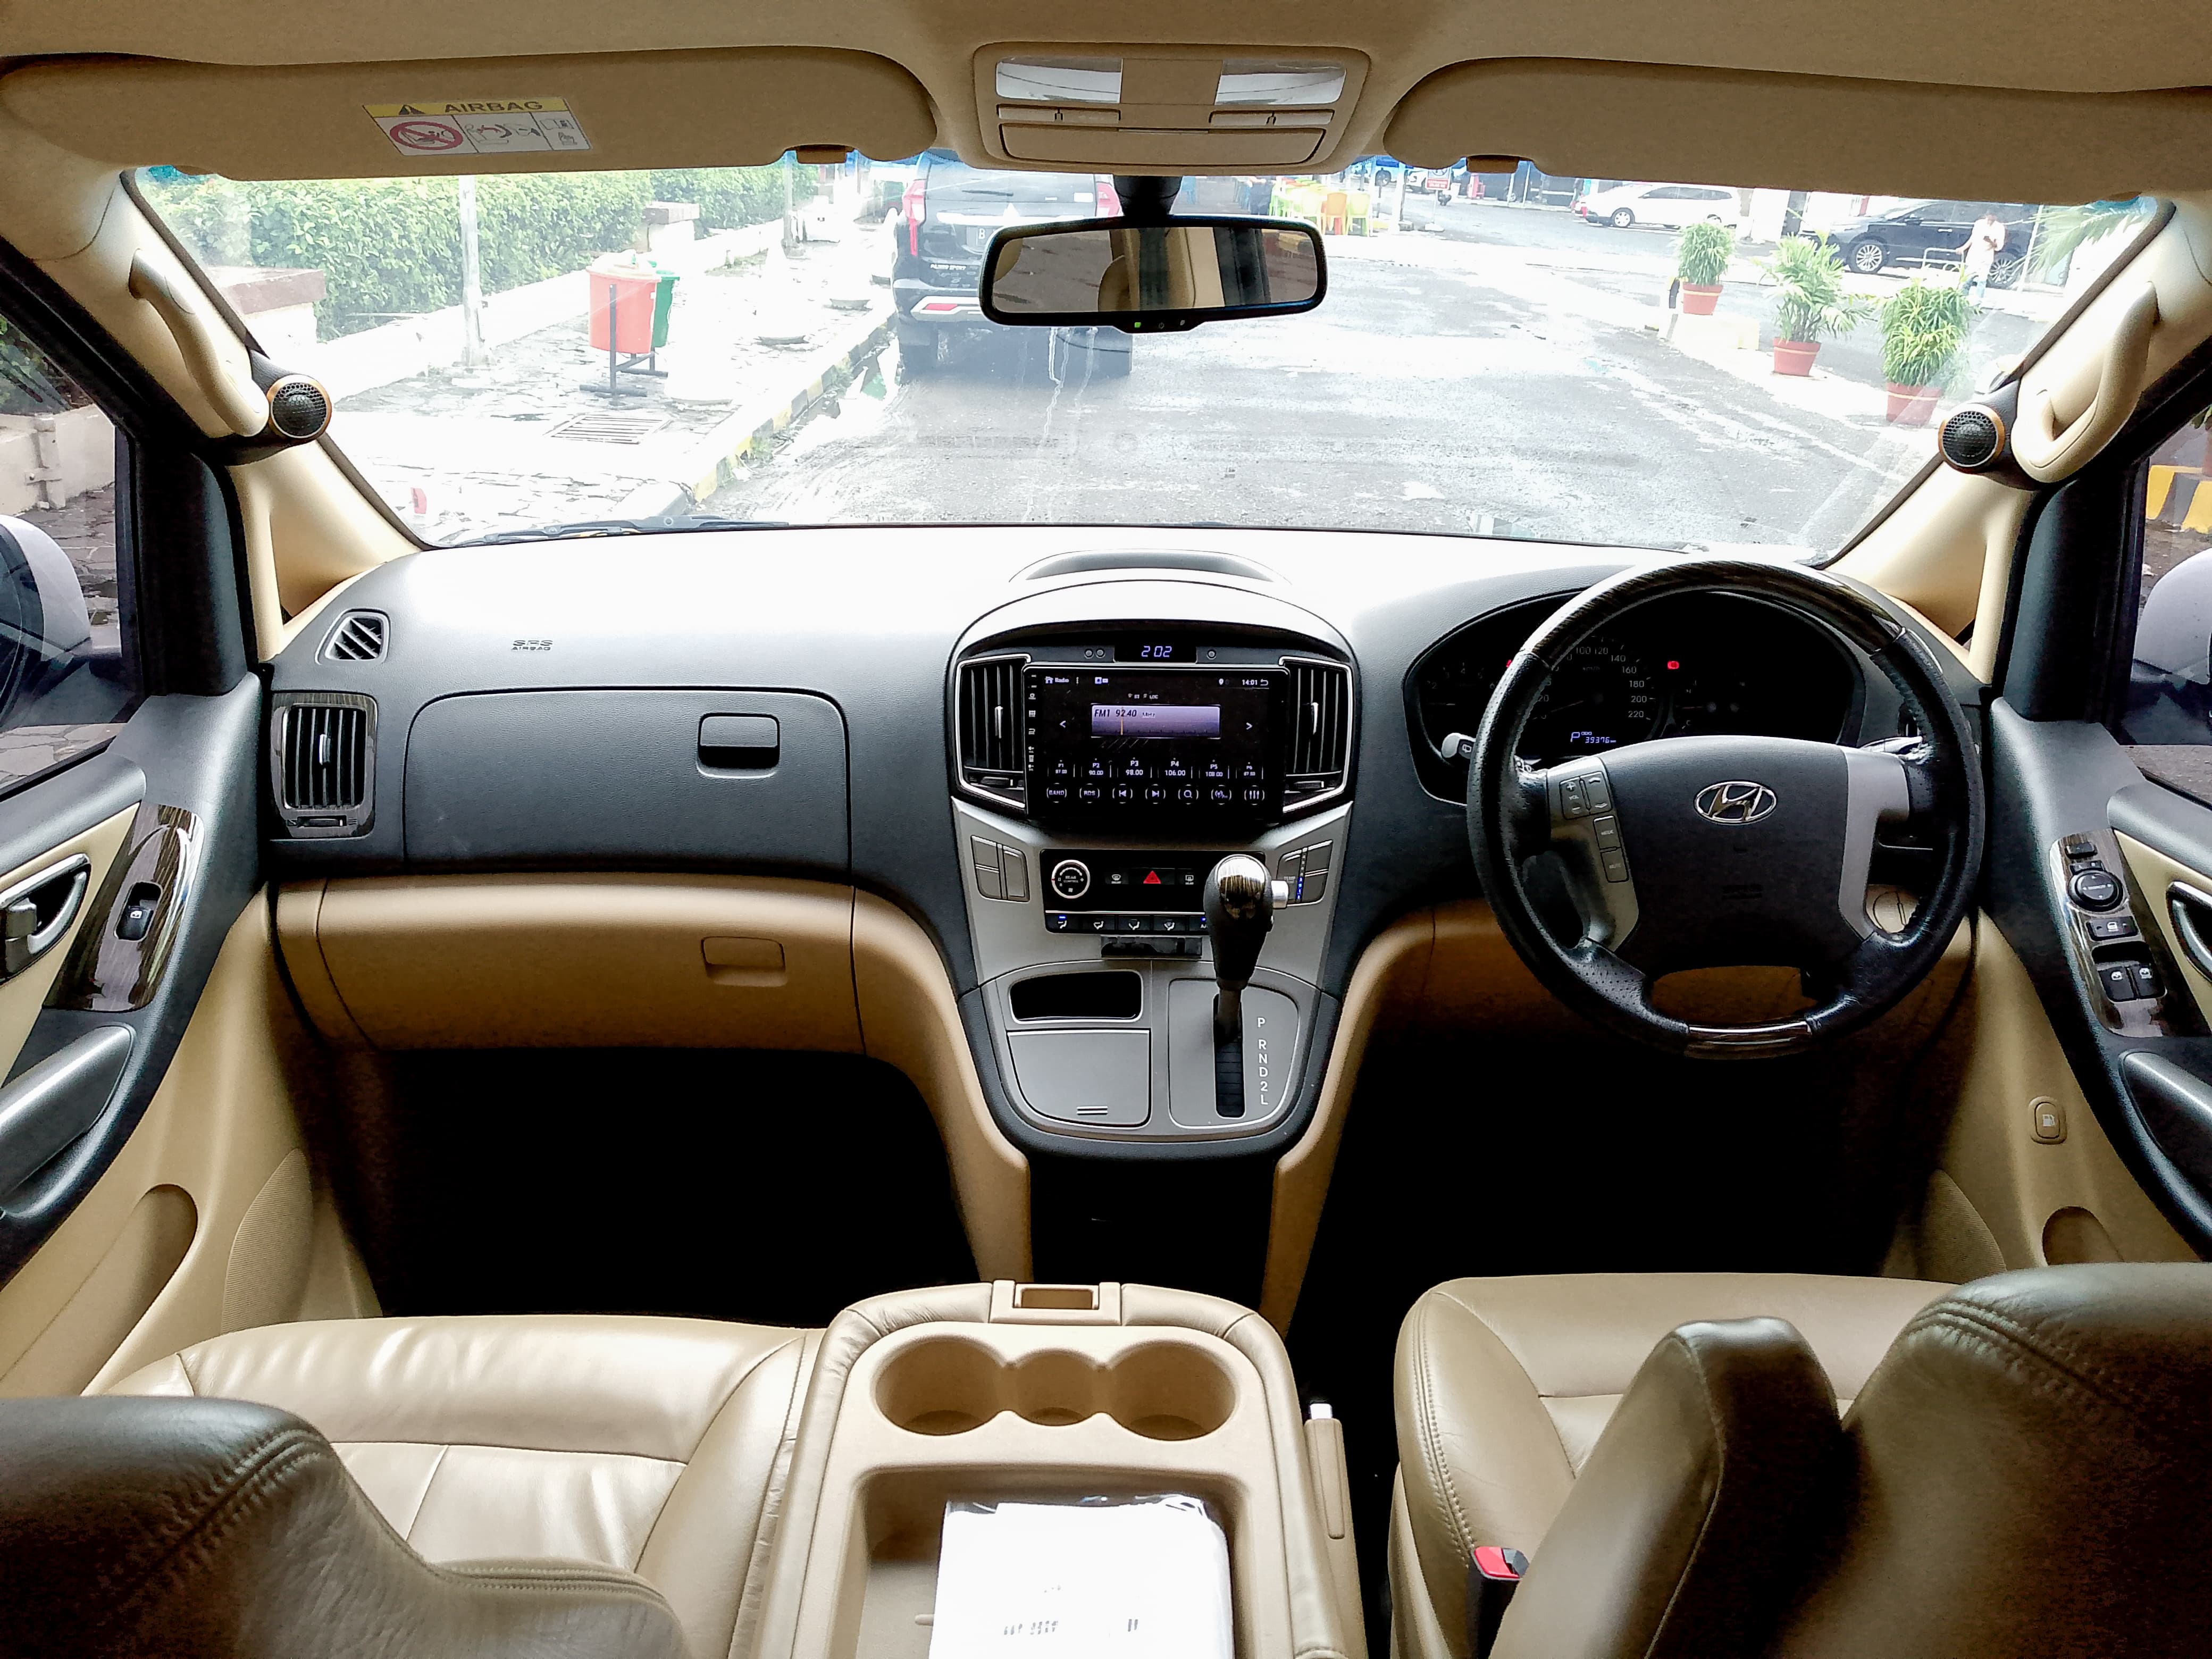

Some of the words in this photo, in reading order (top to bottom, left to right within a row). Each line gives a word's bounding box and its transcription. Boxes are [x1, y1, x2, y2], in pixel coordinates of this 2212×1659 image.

[445, 101, 543, 113] AIRBAG
[978, 228, 985, 239] B
[1094, 709, 1110, 717] FM1
[1116, 709, 1137, 717] 92.40
[1570, 732, 1580, 742] P
[1257, 1017, 1266, 1028] P
[1258, 1039, 1267, 1050] R
[1259, 1053, 1268, 1064] N
[1259, 1066, 1268, 1077] D
[1260, 1080, 1268, 1092] 2
[1260, 1094, 1269, 1105] L
